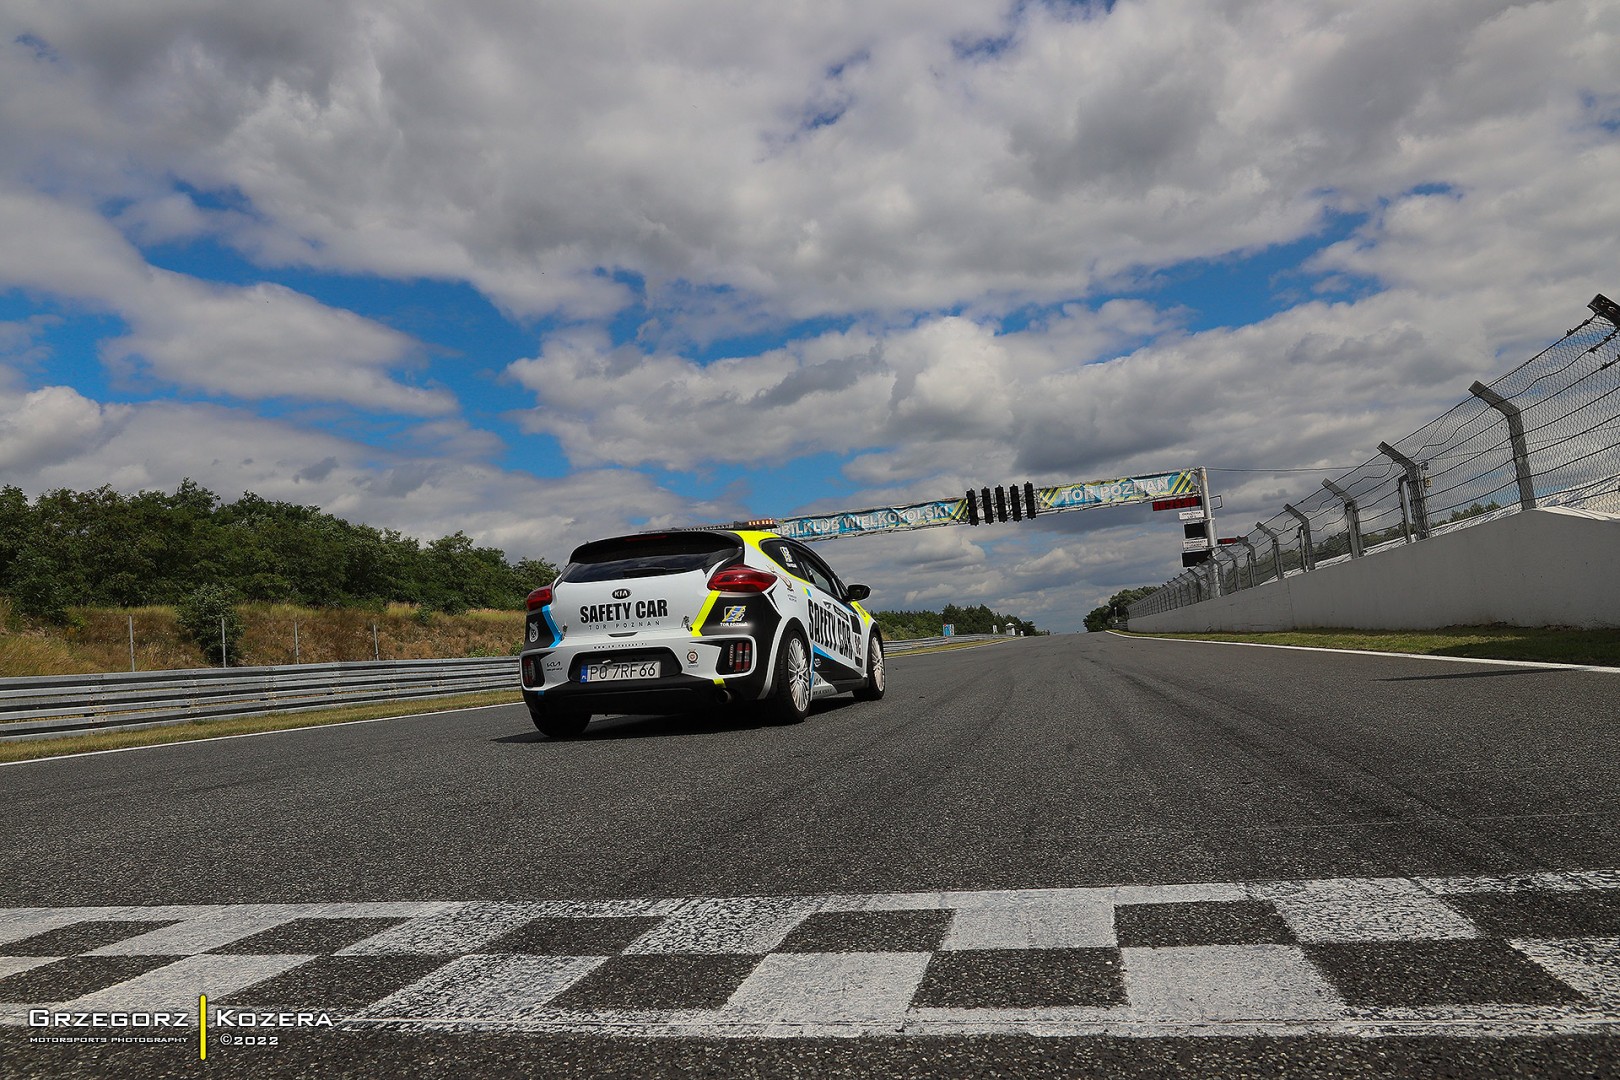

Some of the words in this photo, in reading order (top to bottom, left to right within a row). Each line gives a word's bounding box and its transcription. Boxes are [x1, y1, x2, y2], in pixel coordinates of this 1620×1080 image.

[1062, 489, 1095, 502] TOR
[613, 589, 630, 599] KIA
[580, 602, 631, 624] SAFETY
[635, 599, 668, 619] CAR
[808, 598, 835, 651] SAFETY
[611, 662, 656, 679] 7RF66
